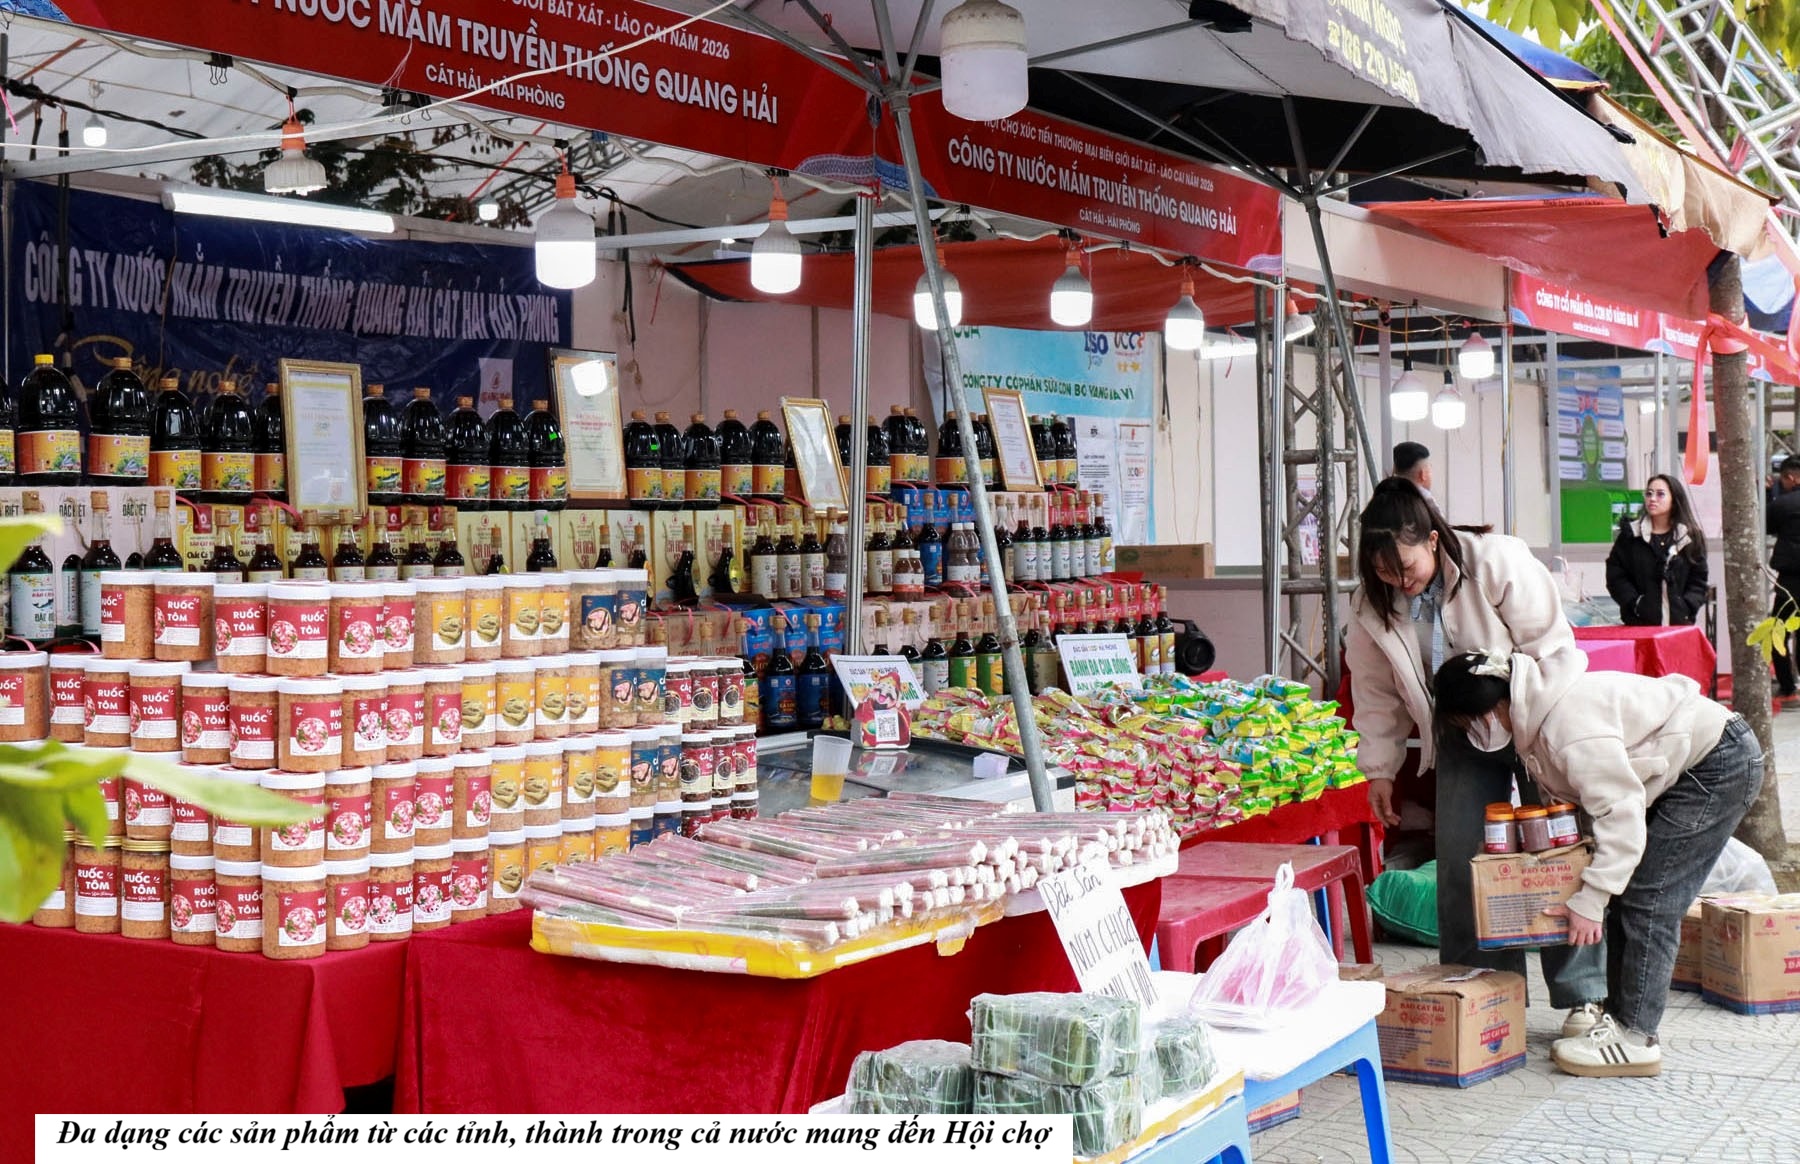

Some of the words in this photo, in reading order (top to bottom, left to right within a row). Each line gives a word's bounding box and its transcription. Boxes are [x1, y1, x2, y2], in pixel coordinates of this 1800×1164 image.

[577, 3, 604, 26] XÁT
[614, 11, 640, 36] LÀO
[670, 28, 699, 51] NĂM
[702, 38, 730, 60] 2026
[457, 18, 557, 72] TRUYỀN
[562, 41, 650, 94] THỐNG
[655, 68, 738, 114] QUANG
[742, 82, 778, 124] HẢI
[425, 62, 456, 84] CÁT
[457, 67, 482, 91] HẢI
[491, 76, 514, 100] HẢI
[517, 85, 566, 110] PHÒNG
[1001, 119, 1019, 139] CHỢ
[1020, 122, 1037, 140] XÚC
[1038, 126, 1053, 145] TIẾN
[1054, 134, 1083, 153] THƯƠNG
[1084, 142, 1098, 160] MẠI
[1115, 151, 1130, 168] GIỚI
[1160, 162, 1173, 180] LÀO
[1173, 170, 1185, 184] CAI
[1185, 171, 1200, 189] NĂM
[1200, 177, 1214, 192] 2026
[948, 135, 995, 172] CÔNG
[998, 151, 1013, 177] TY
[1016, 154, 1056, 188] NƯỚC
[1059, 160, 1091, 197] MẮM
[1138, 185, 1178, 219] THỐNG
[1179, 201, 1218, 230] QUANG
[1219, 206, 1237, 235] HẢI
[1119, 217, 1141, 234] PHÒNG
[84, 250, 109, 308] TY
[113, 246, 166, 314] NƯỚC
[224, 254, 298, 327] TRUYỀN
[299, 258, 355, 331] THỐNG
[354, 280, 406, 338] QUANG
[168, 599, 194, 610] RUỐC
[168, 611, 188, 622] TÔM
[233, 608, 261, 620] RUỐC
[300, 612, 325, 623] RUỐC
[233, 621, 255, 632] TÔM
[300, 624, 321, 635] TÔM
[56, 679, 81, 689] RUỐC
[56, 691, 75, 701] TÔM
[97, 687, 125, 698] RUỐC
[142, 691, 169, 703] RUỐC
[97, 699, 118, 711] TÔM
[142, 704, 164, 715] TÔM
[205, 713, 226, 725] TÔM
[240, 712, 267, 723] RUỐC
[240, 724, 261, 736] TÔM
[142, 792, 164, 803] TÔM
[176, 807, 195, 818] TÔM
[78, 867, 104, 880] RUỐC
[124, 871, 151, 884] RUỐC
[85, 880, 110, 891] TÔM
[131, 884, 157, 895] TÔM
[194, 885, 216, 897] RUỐ
[194, 898, 216, 909] TÔM
[237, 905, 260, 915] TÔM
